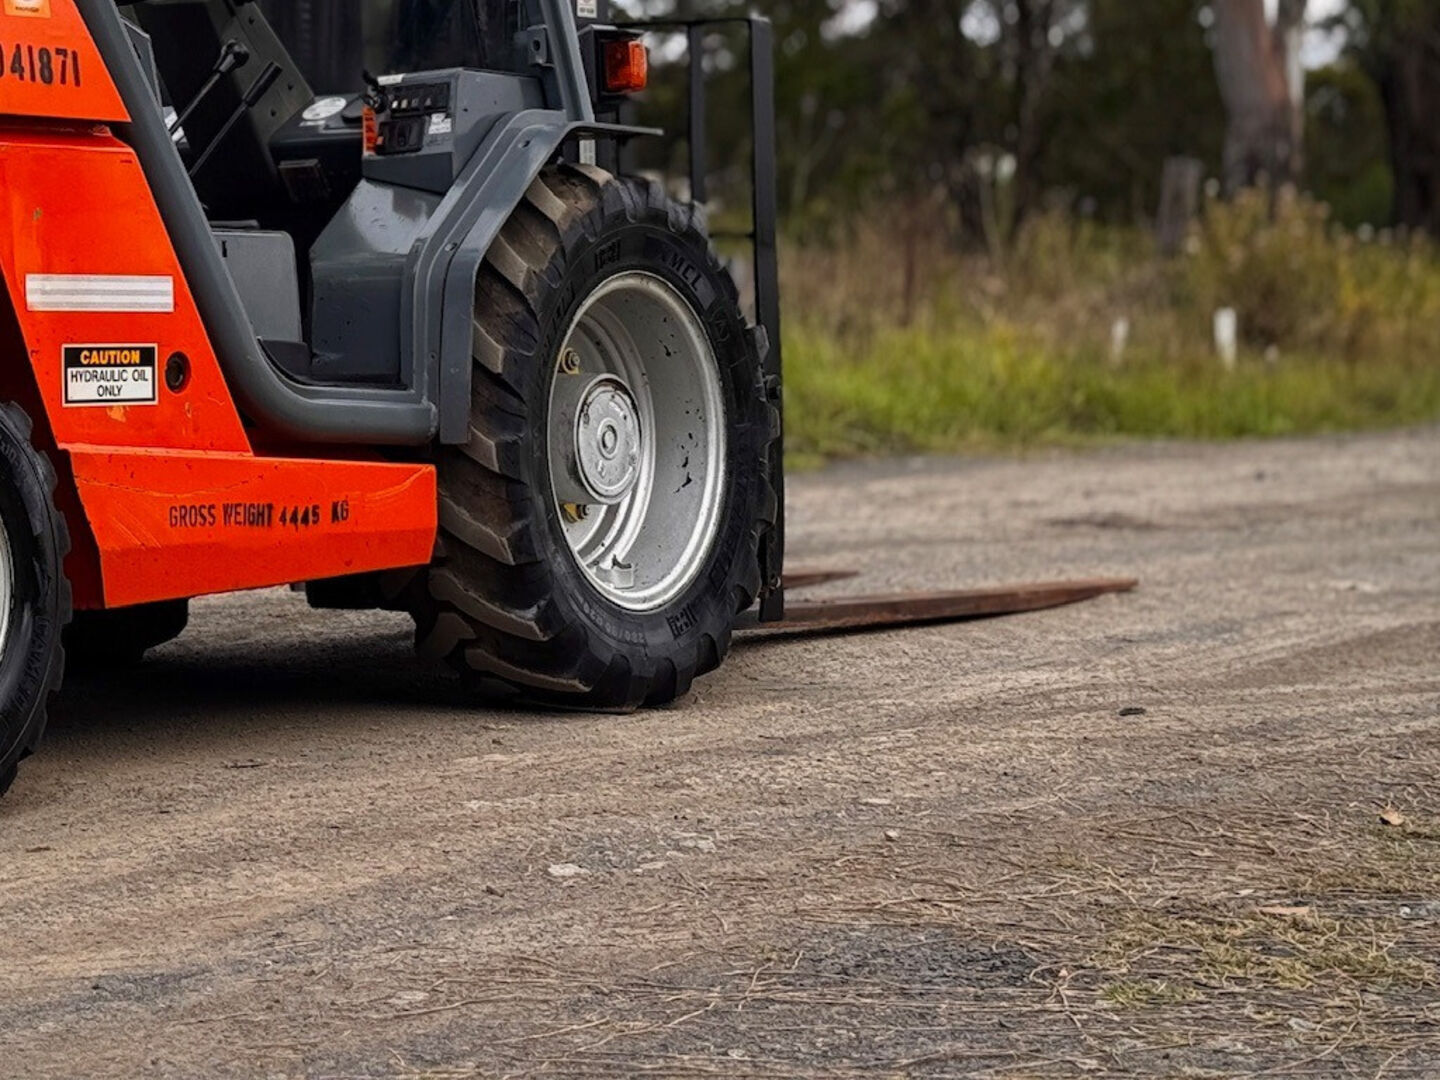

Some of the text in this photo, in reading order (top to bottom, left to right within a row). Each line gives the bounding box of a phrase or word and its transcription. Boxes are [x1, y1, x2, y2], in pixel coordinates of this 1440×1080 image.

[80, 350, 140, 365] CAUTION
[70, 369, 148, 383] HYDRAULIC OIL
[97, 385, 123, 397] ONLY
[169, 504, 216, 528] GROSS
[222, 503, 274, 526] WEIGHT
[331, 500, 350, 523] KG
